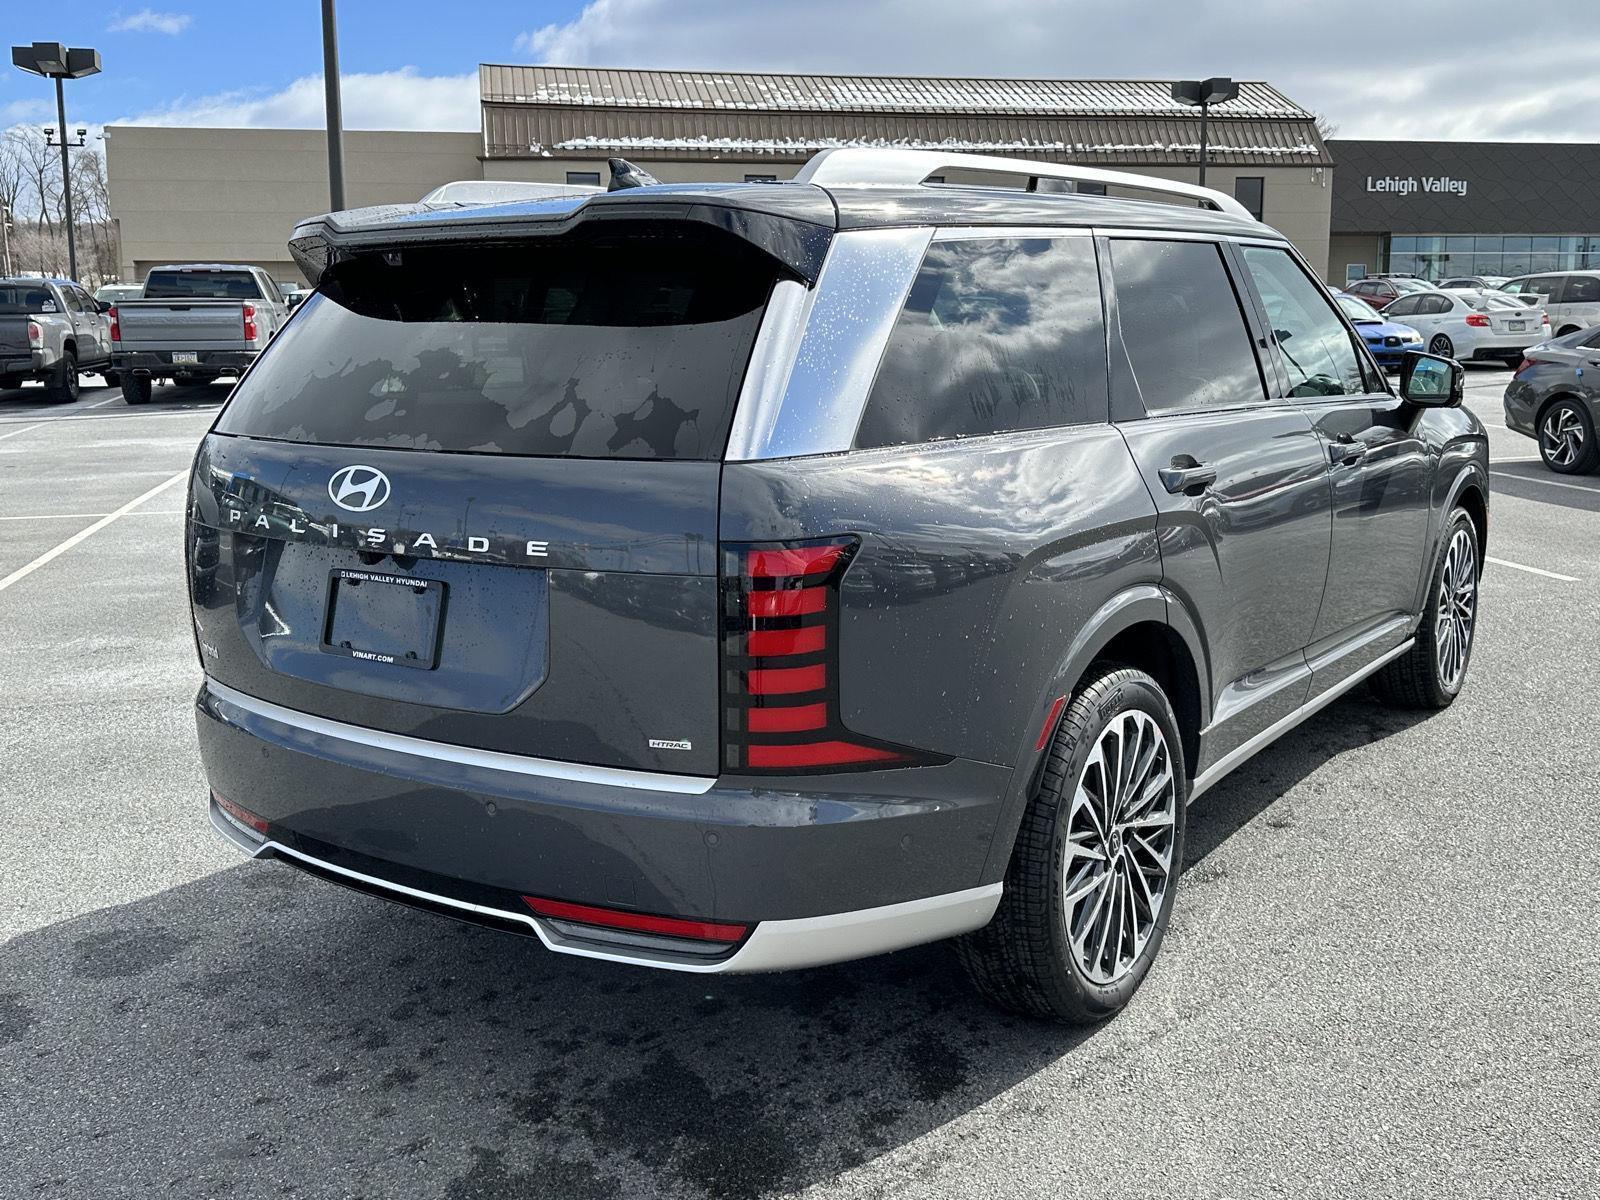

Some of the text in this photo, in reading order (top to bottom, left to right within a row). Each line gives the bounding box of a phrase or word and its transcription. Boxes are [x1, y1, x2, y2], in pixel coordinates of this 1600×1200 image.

[1366, 176, 1468, 197] Lehigh Valley
[229, 509, 549, 558] PALISADE
[346, 571, 428, 588] LEHIGH VALLEY HYUNDAI
[352, 650, 394, 664] VINART.COM
[651, 741, 688, 749] HTRAC
